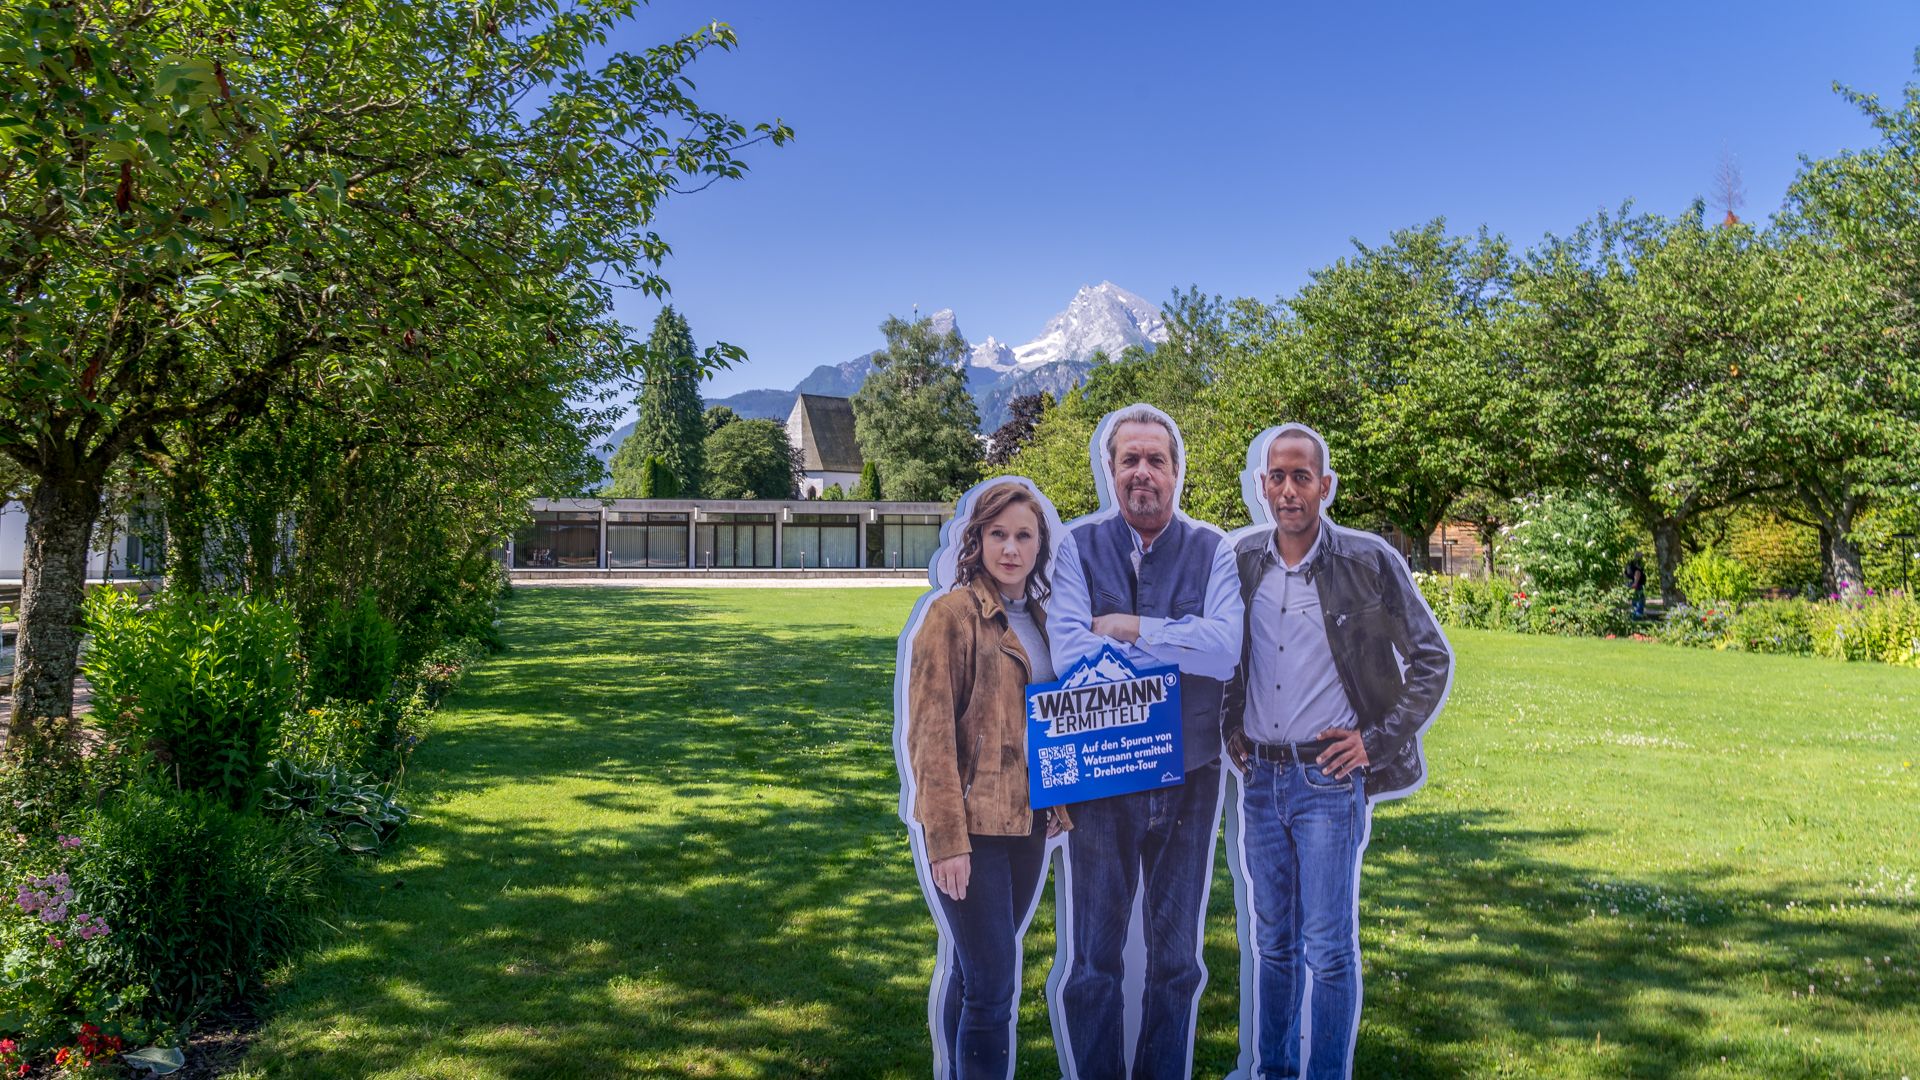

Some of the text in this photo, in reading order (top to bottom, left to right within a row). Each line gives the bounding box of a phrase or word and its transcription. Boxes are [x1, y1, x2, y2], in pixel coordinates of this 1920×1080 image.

[1038, 677, 1162, 719] WATZMANN
[1056, 704, 1147, 734] ERMITTELT
[1082, 732, 1172, 754] Auf den Spuren von
[1083, 743, 1173, 766] Watzmann ermittelt
[1094, 760, 1158, 778] Drehorte-Tour
